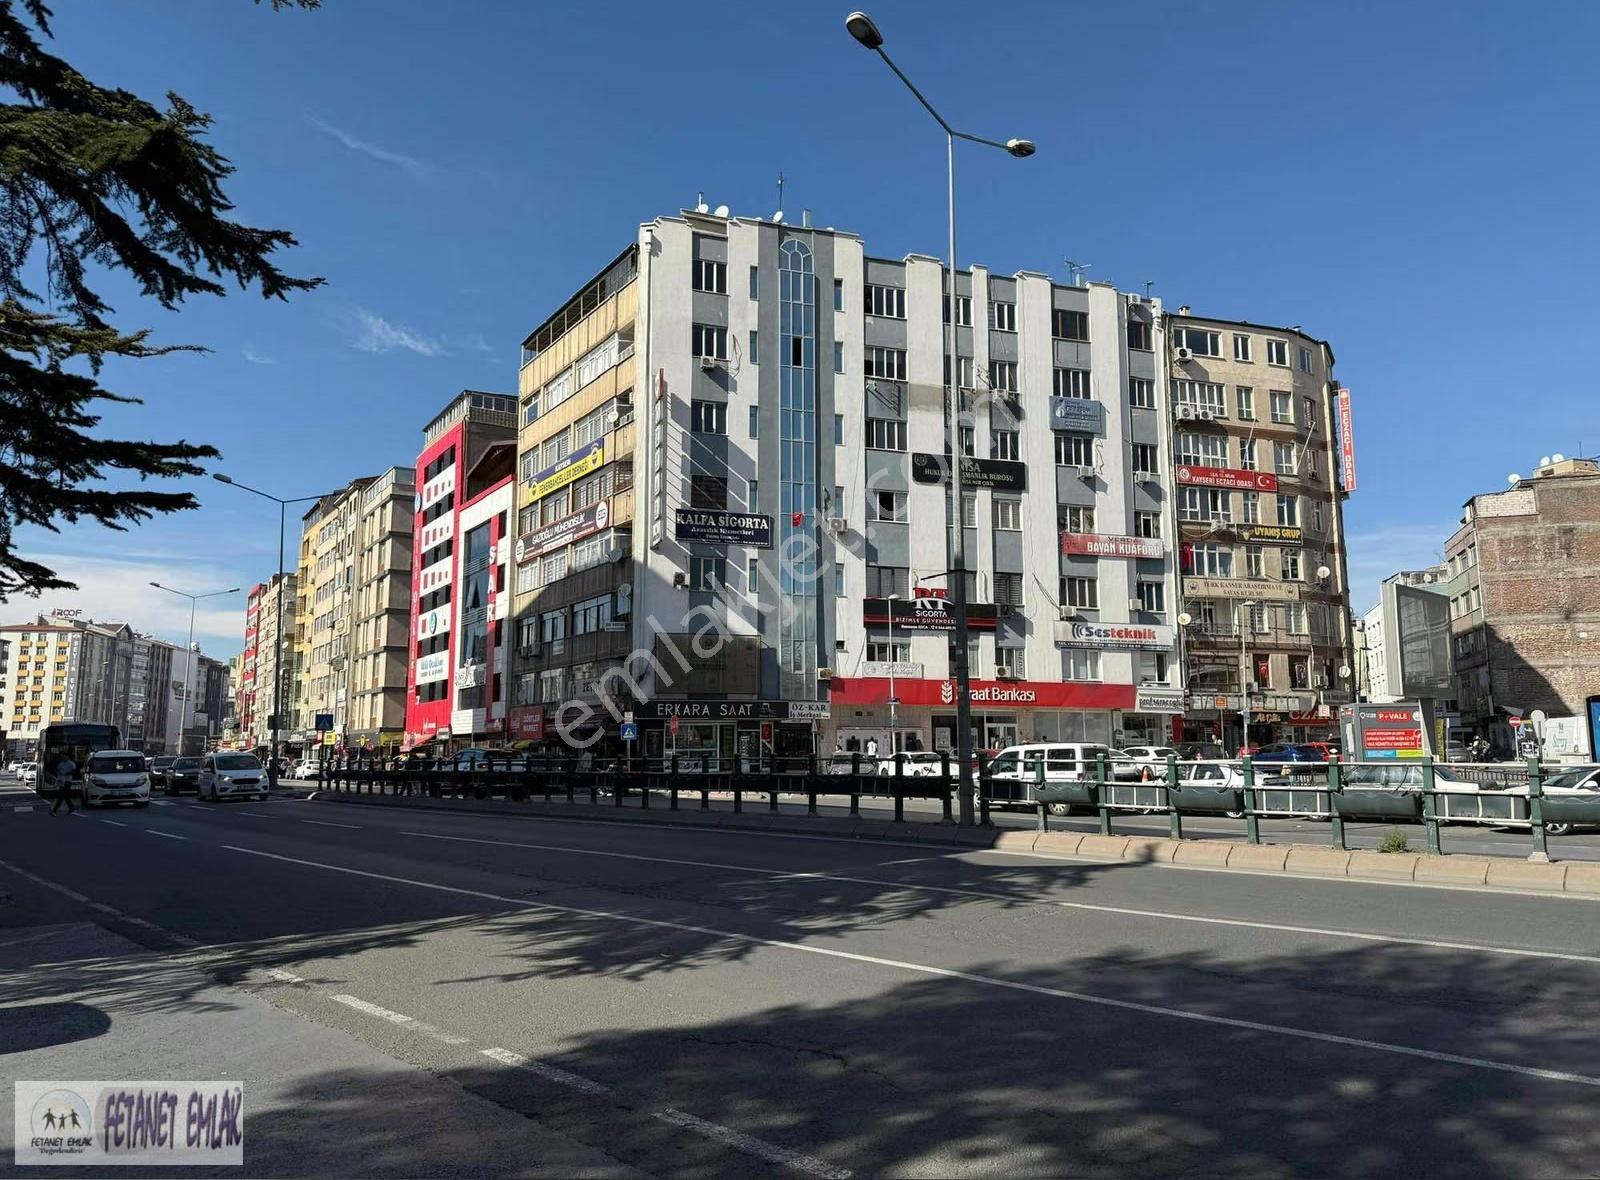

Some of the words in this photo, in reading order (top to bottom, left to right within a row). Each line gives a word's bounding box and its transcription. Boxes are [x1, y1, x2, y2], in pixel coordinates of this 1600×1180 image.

[676, 513, 716, 526] KALFA
[718, 514, 769, 529] SİGORTA
[1087, 542, 1116, 553] BAYAN
[1085, 626, 1157, 640] Sesteknik
[991, 687, 1036, 701] Bankası
[656, 703, 710, 716] ERKARA
[719, 703, 752, 716] SAAT
